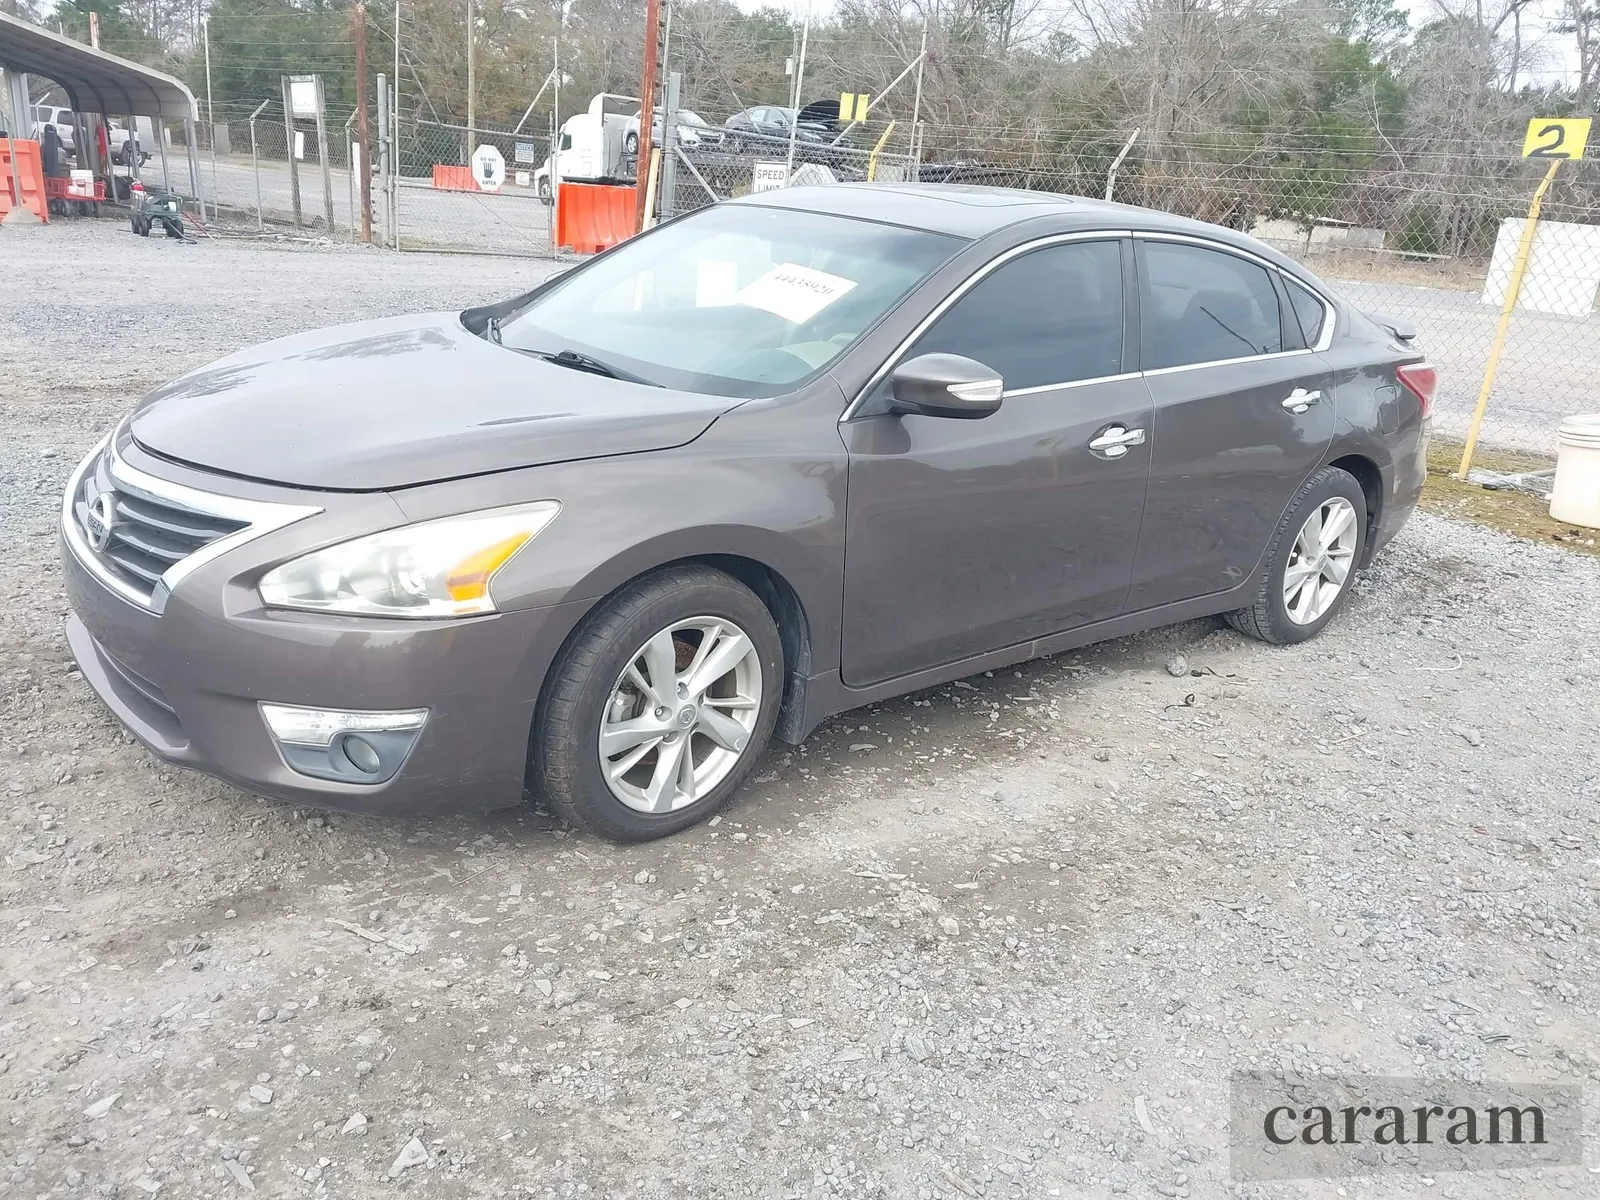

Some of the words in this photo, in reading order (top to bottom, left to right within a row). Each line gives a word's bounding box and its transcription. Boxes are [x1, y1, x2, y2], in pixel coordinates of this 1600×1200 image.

[851, 93, 859, 120] 1
[1527, 124, 1571, 158] 2
[757, 169, 785, 180] SPEED
